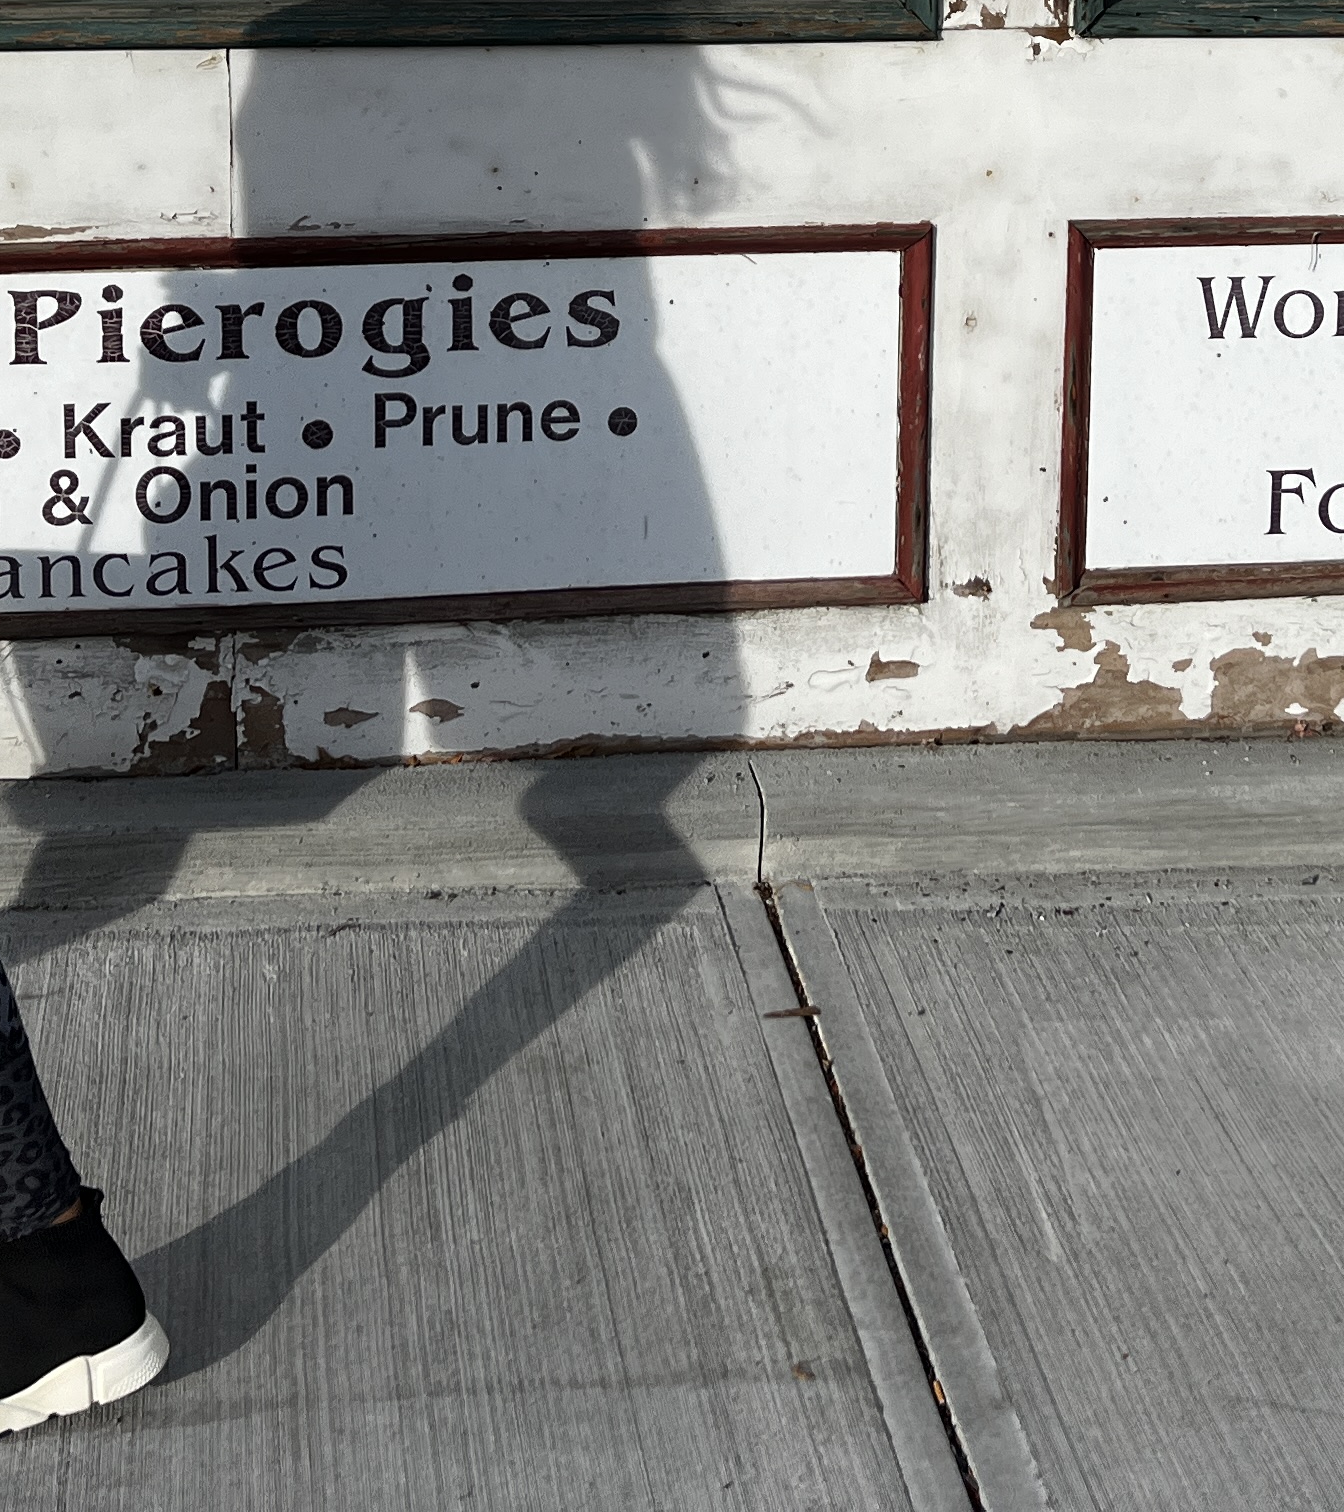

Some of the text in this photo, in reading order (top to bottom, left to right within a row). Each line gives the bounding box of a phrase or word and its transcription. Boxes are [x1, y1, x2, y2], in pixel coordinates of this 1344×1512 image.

[7, 273, 621, 379] Pierogies
[62, 400, 266, 460] Kraut
[374, 391, 582, 449] Prune
[41, 468, 94, 527] &
[135, 463, 355, 525] Onion
